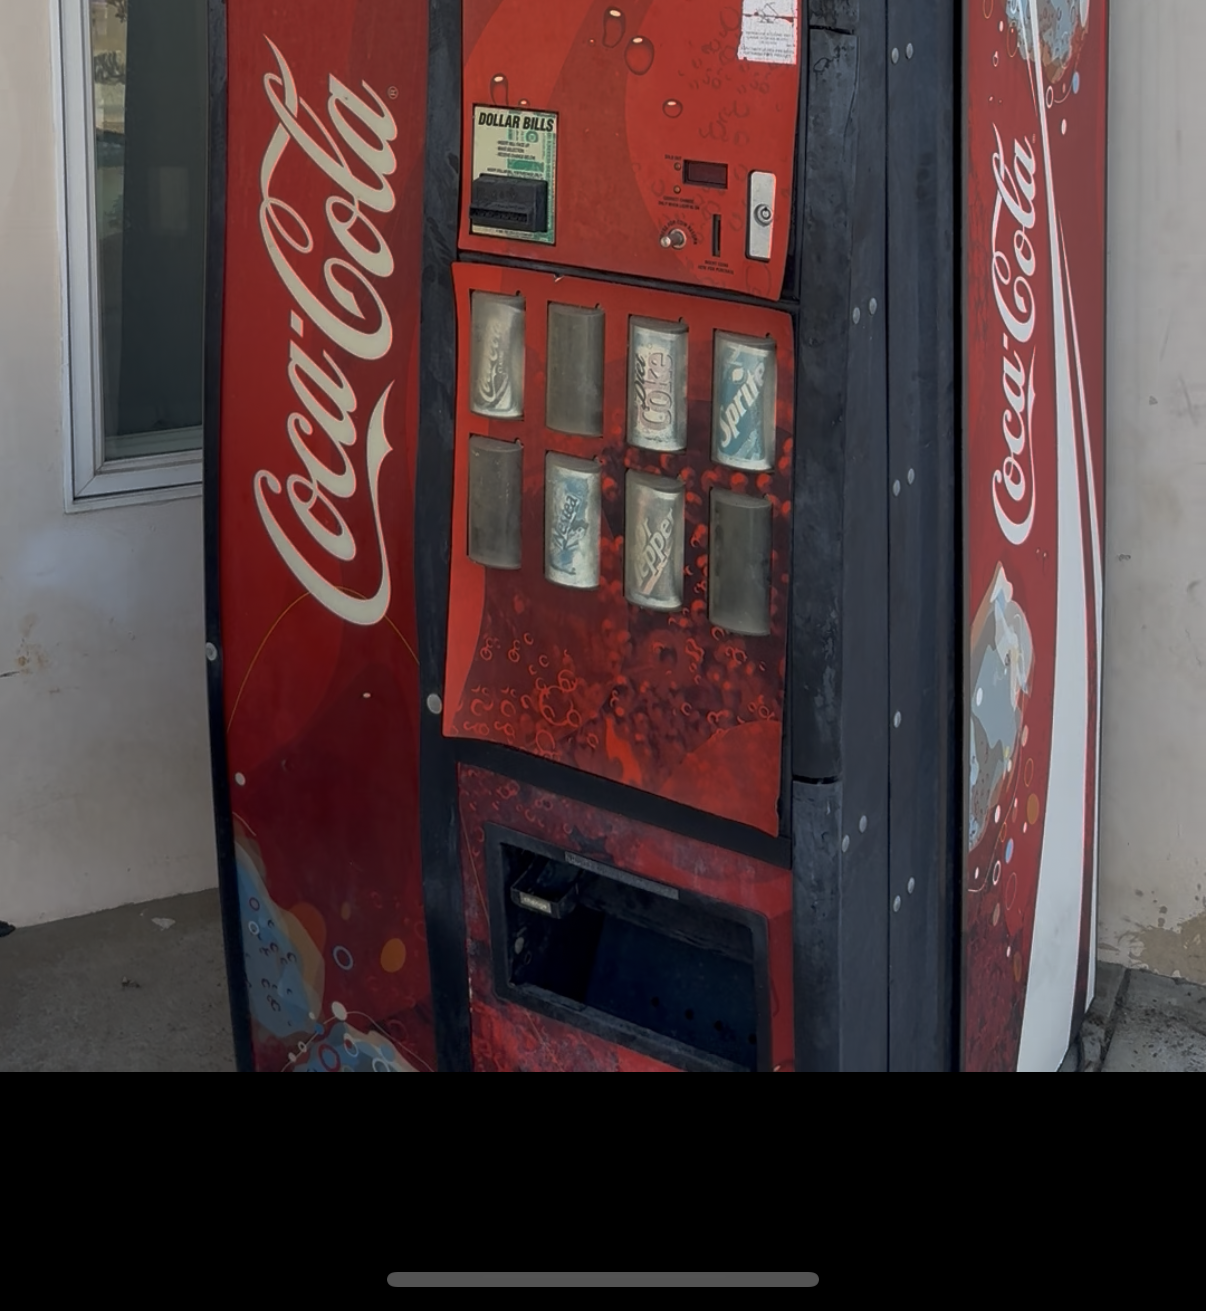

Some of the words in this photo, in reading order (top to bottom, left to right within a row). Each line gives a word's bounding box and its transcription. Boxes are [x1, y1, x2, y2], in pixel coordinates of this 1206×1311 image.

[478, 112, 520, 129] DOLLAR
[522, 116, 555, 133] BILLS
[254, 33, 398, 626] Coca-Cola
[991, 122, 1037, 546] Coca-Cola
[641, 351, 673, 430] Coke
[719, 361, 766, 448] Sprite
